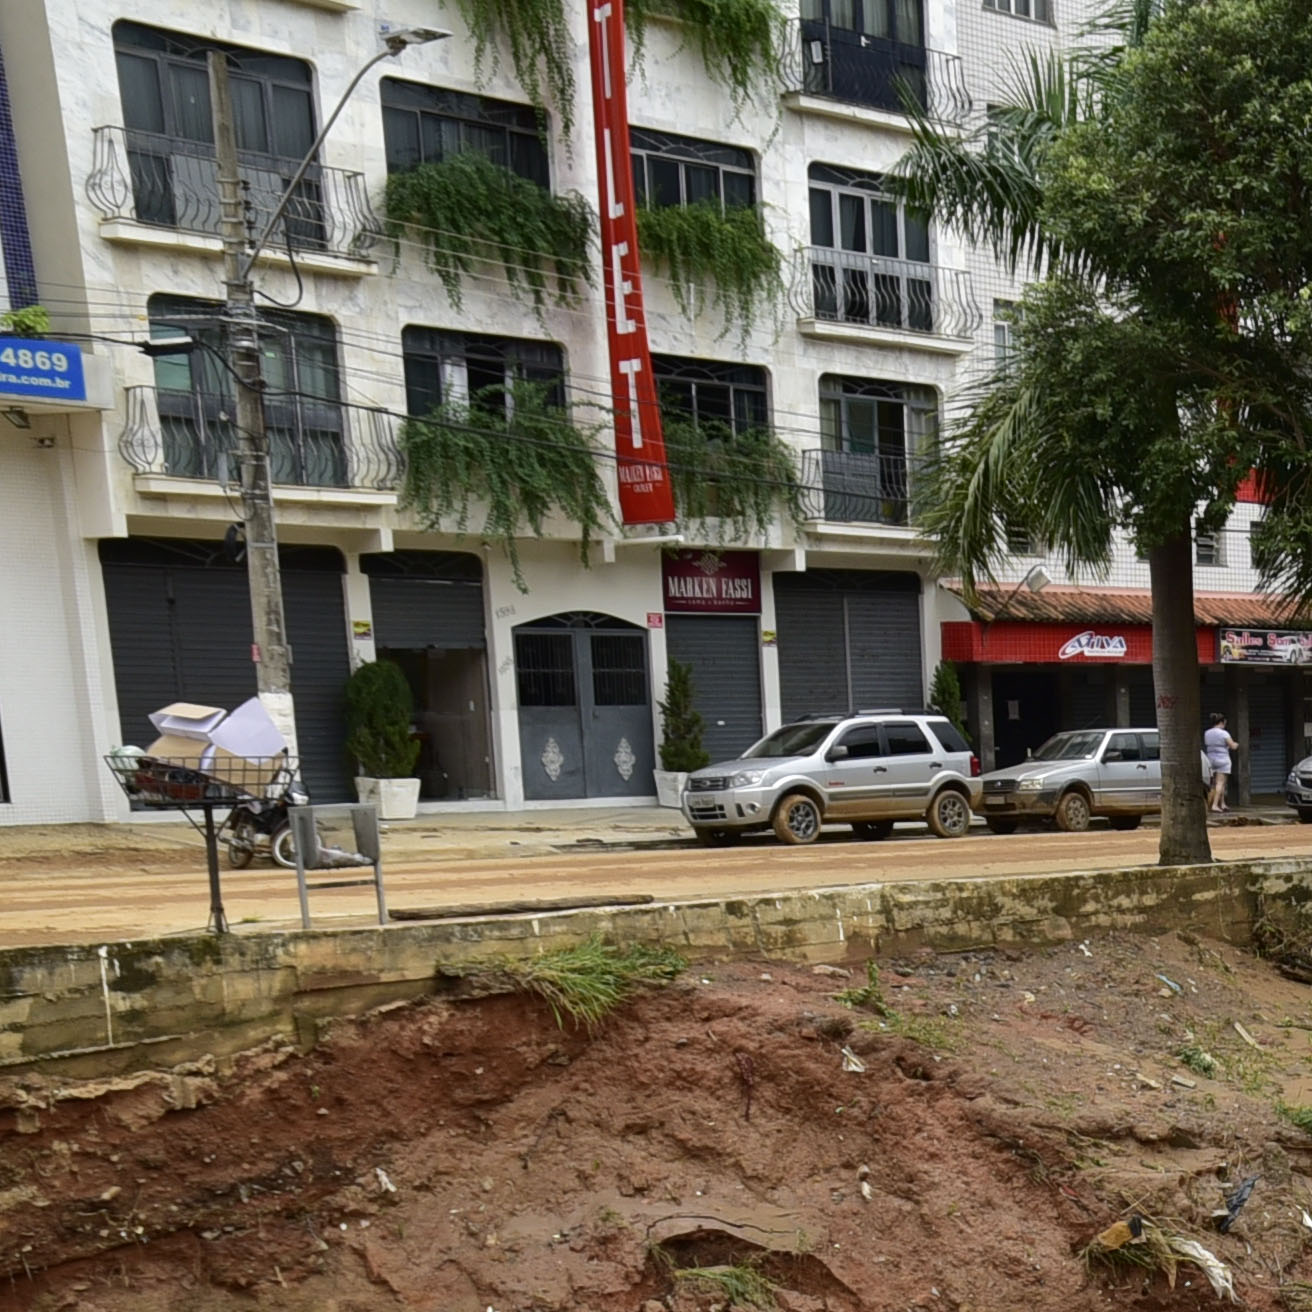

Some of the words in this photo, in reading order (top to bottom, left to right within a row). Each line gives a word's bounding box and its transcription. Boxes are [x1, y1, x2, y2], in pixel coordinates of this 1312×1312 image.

[0, 347, 68, 372] 4869
[667, 575, 718, 598] MARKEN
[721, 577, 752, 599] FASSI
